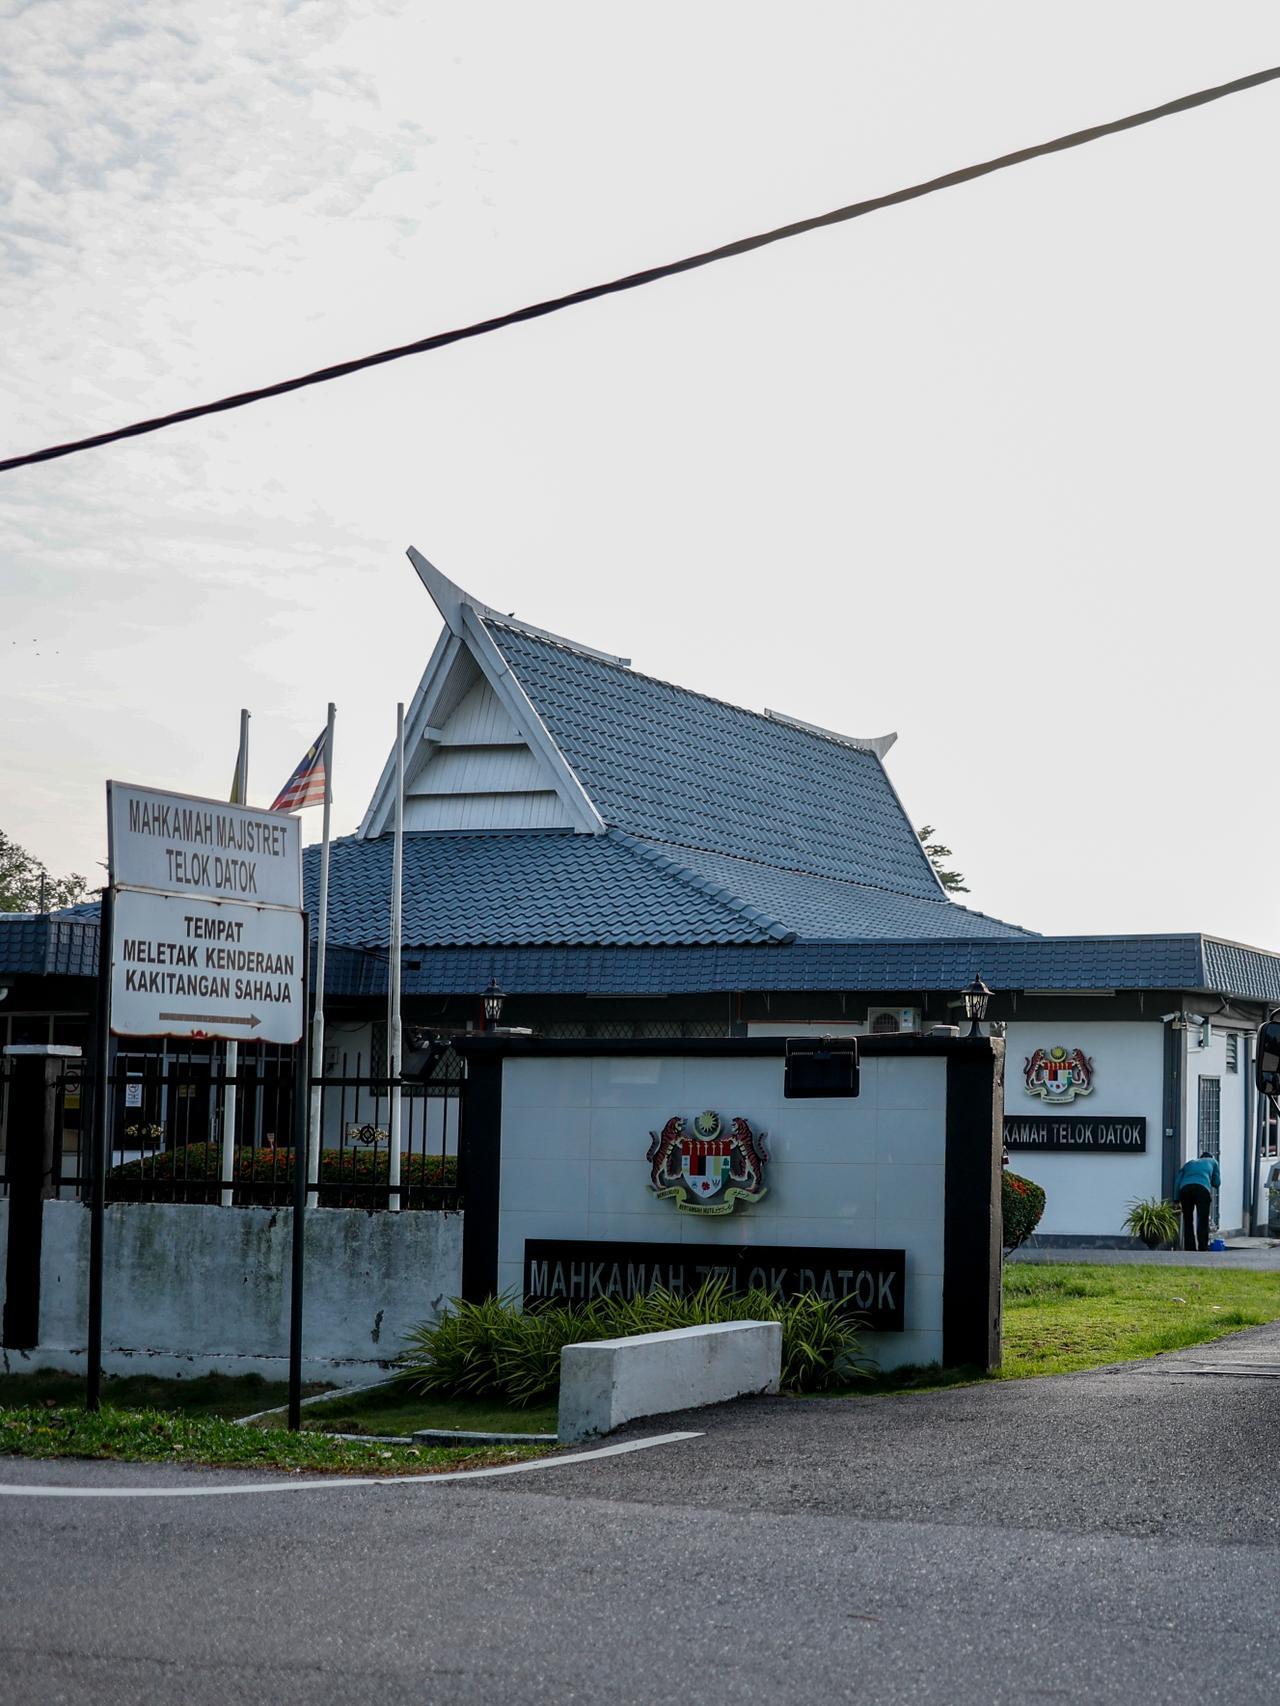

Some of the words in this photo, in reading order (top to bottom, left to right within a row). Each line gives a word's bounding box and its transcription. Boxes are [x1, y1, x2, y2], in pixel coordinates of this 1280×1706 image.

[129, 799, 213, 846] MAHKAMAH
[216, 815, 288, 858] MAJISTRET
[166, 848, 211, 887] TELOK
[214, 856, 258, 894] DATOK
[184, 916, 244, 943] TEMPAT
[123, 939, 198, 967] MELETAK
[205, 947, 294, 976] KENDERAAN
[125, 969, 230, 999] KAKITANGAN
[234, 978, 292, 1003] SAHAJA
[1052, 1123, 1094, 1144] TELOK
[1098, 1124, 1141, 1145] DATOK
[531, 1259, 684, 1300] MAHKAMAH
[695, 1266, 788, 1303] TLOK
[799, 1268, 897, 1310] DATOK
